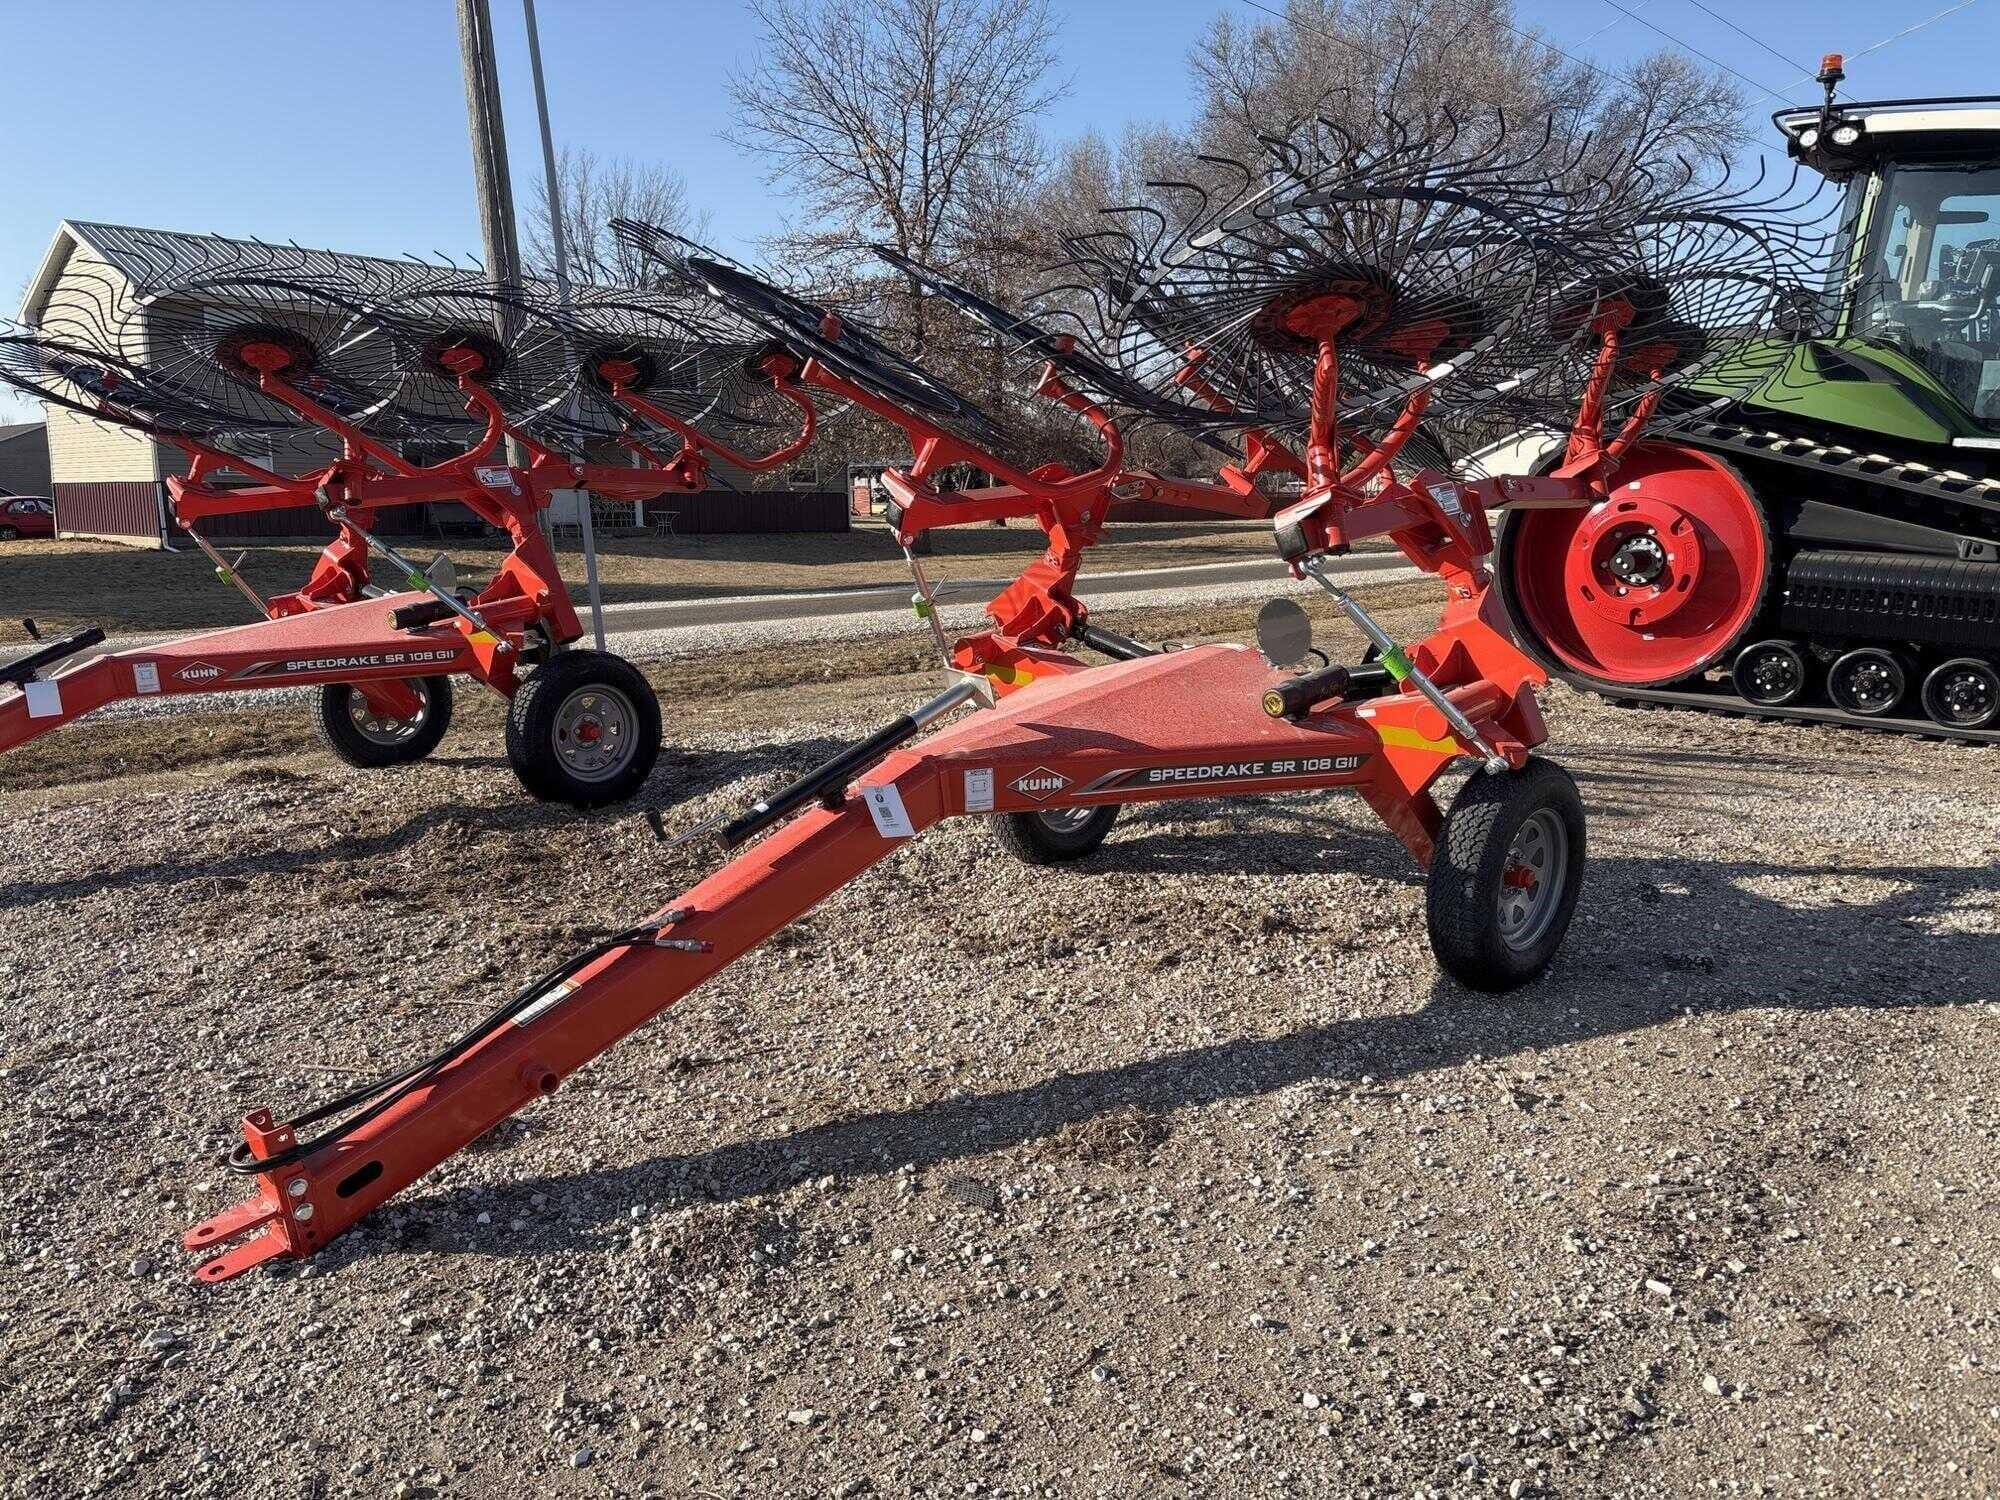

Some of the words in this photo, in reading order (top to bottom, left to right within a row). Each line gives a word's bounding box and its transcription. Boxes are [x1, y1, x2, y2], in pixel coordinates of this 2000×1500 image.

[286, 655, 379, 671] SPEEDRAKE
[385, 653, 405, 663] SR
[409, 651, 433, 661] 108
[181, 667, 218, 679] KUHN
[1149, 763, 1265, 782] SPEEDRAKE
[1271, 760, 1296, 773] SR
[1302, 758, 1331, 771] 108
[1335, 757, 1358, 769] GII
[1018, 777, 1063, 792] KUHN
